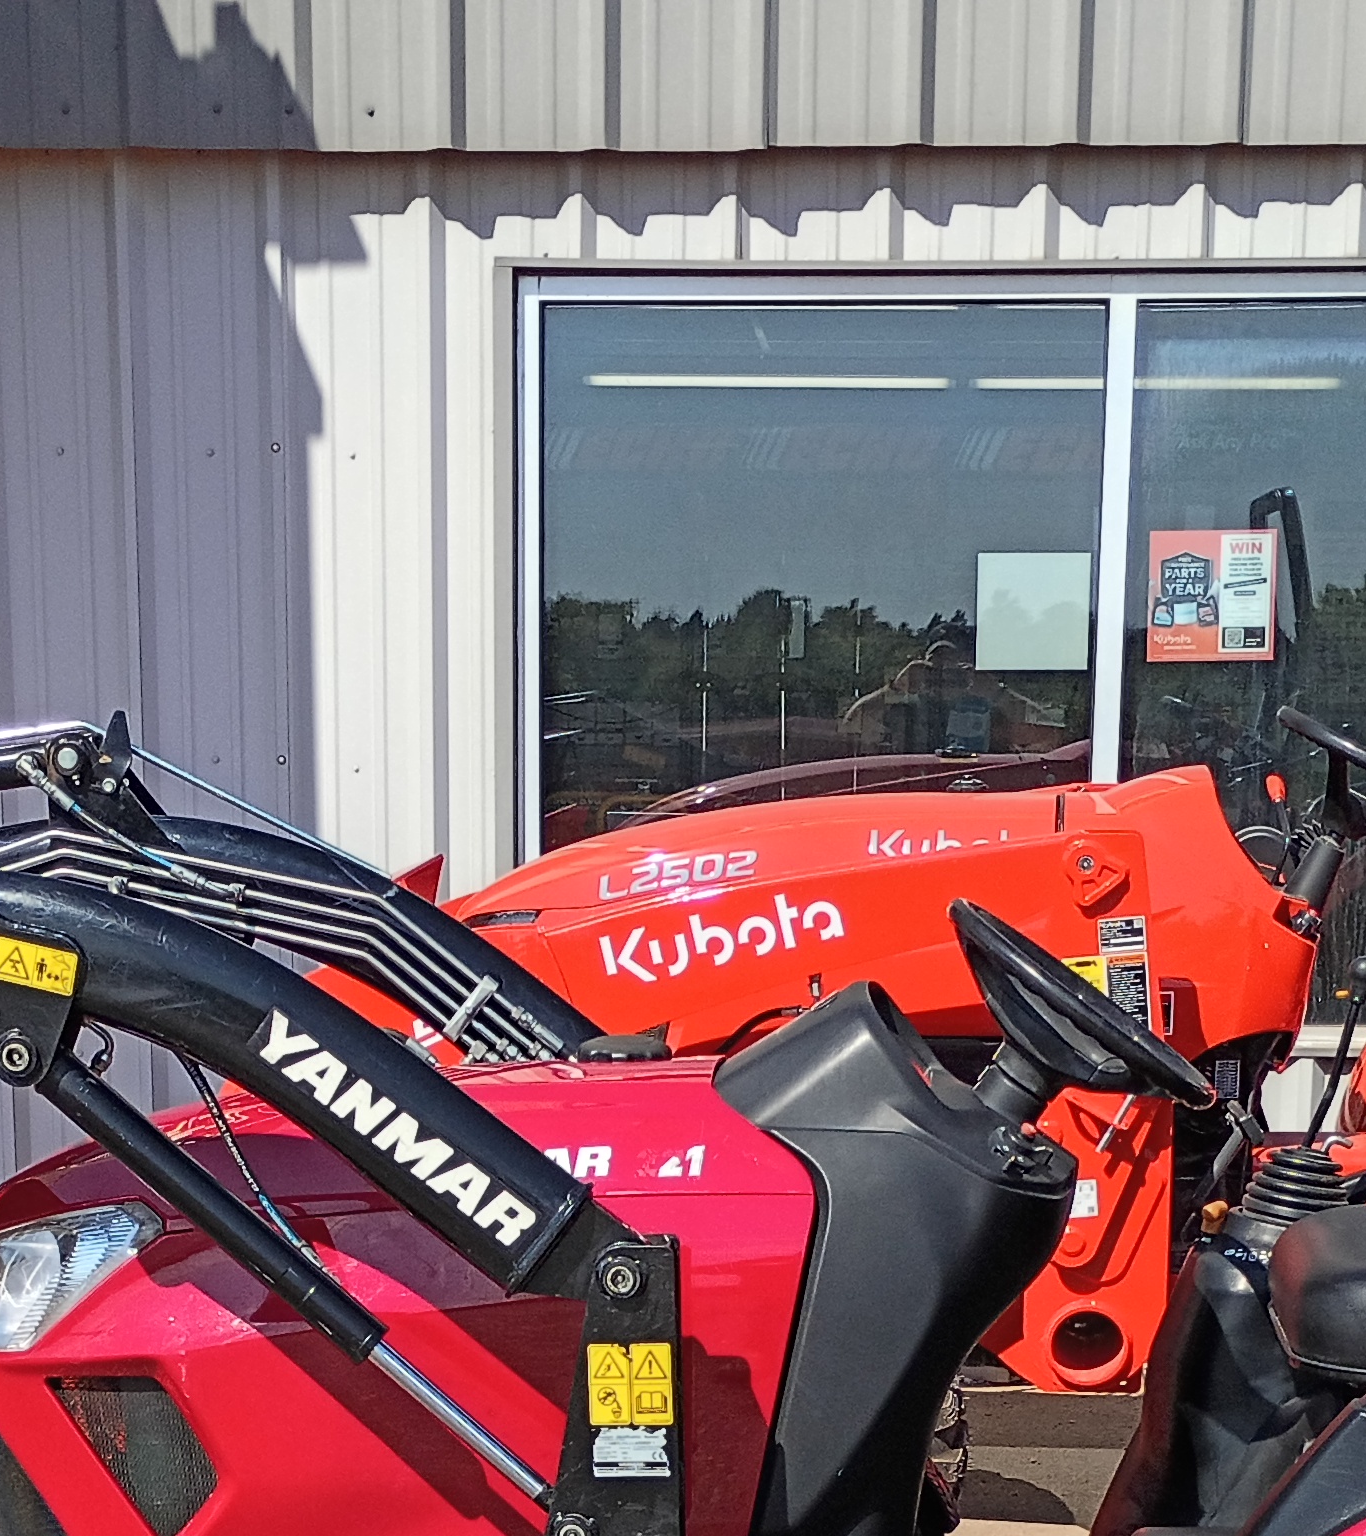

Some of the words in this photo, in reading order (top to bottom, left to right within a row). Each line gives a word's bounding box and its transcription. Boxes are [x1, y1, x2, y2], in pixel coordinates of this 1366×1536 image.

[1229, 541, 1263, 554] WIN
[1164, 567, 1205, 579] PARTS
[1165, 583, 1205, 596] YEAR
[867, 828, 1009, 858] Kub
[597, 850, 759, 902] L2502
[598, 892, 846, 983] Kubota
[259, 1008, 537, 1247] YANMAR
